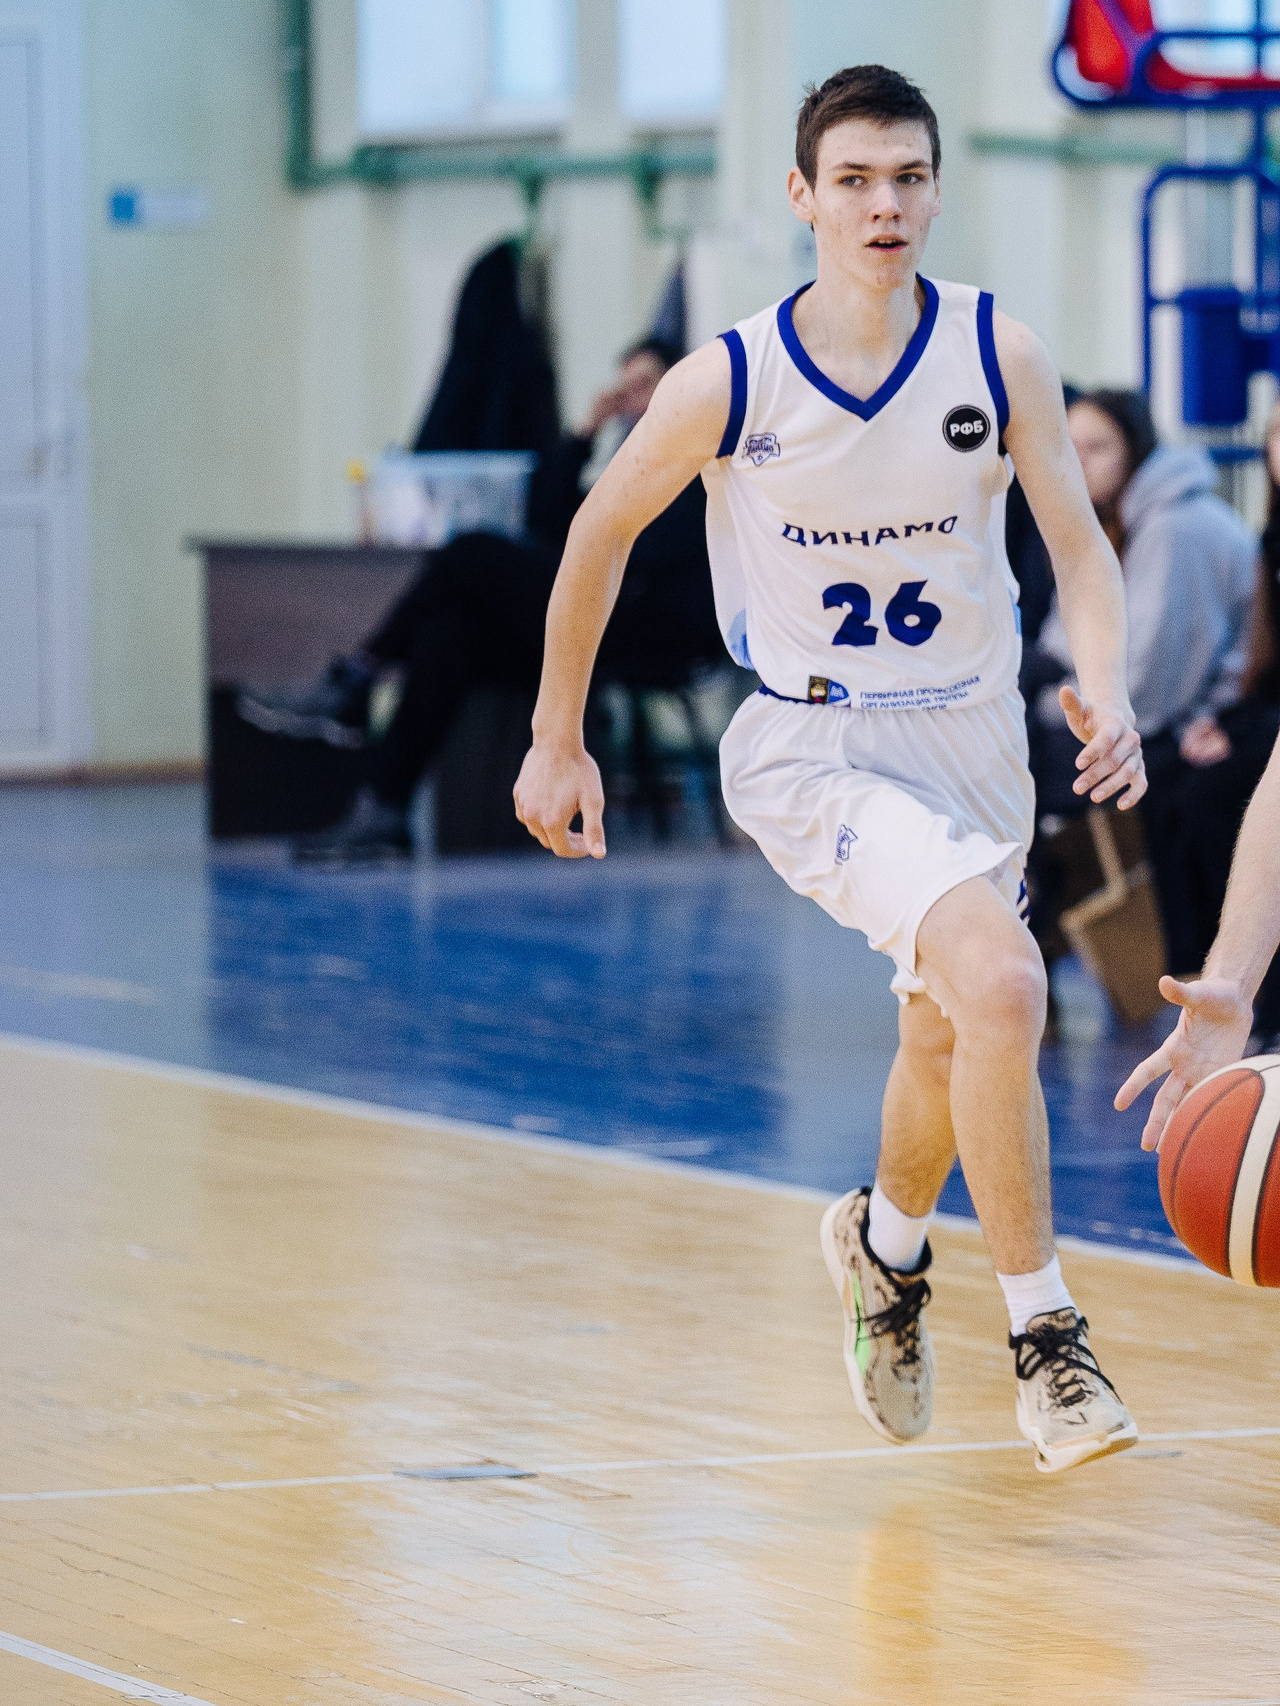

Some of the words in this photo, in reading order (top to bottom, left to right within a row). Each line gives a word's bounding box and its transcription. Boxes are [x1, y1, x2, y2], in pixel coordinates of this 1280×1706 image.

[950, 420, 984, 437] РФБ
[782, 515, 958, 547] ДИНАМО
[822, 579, 942, 646] 26
